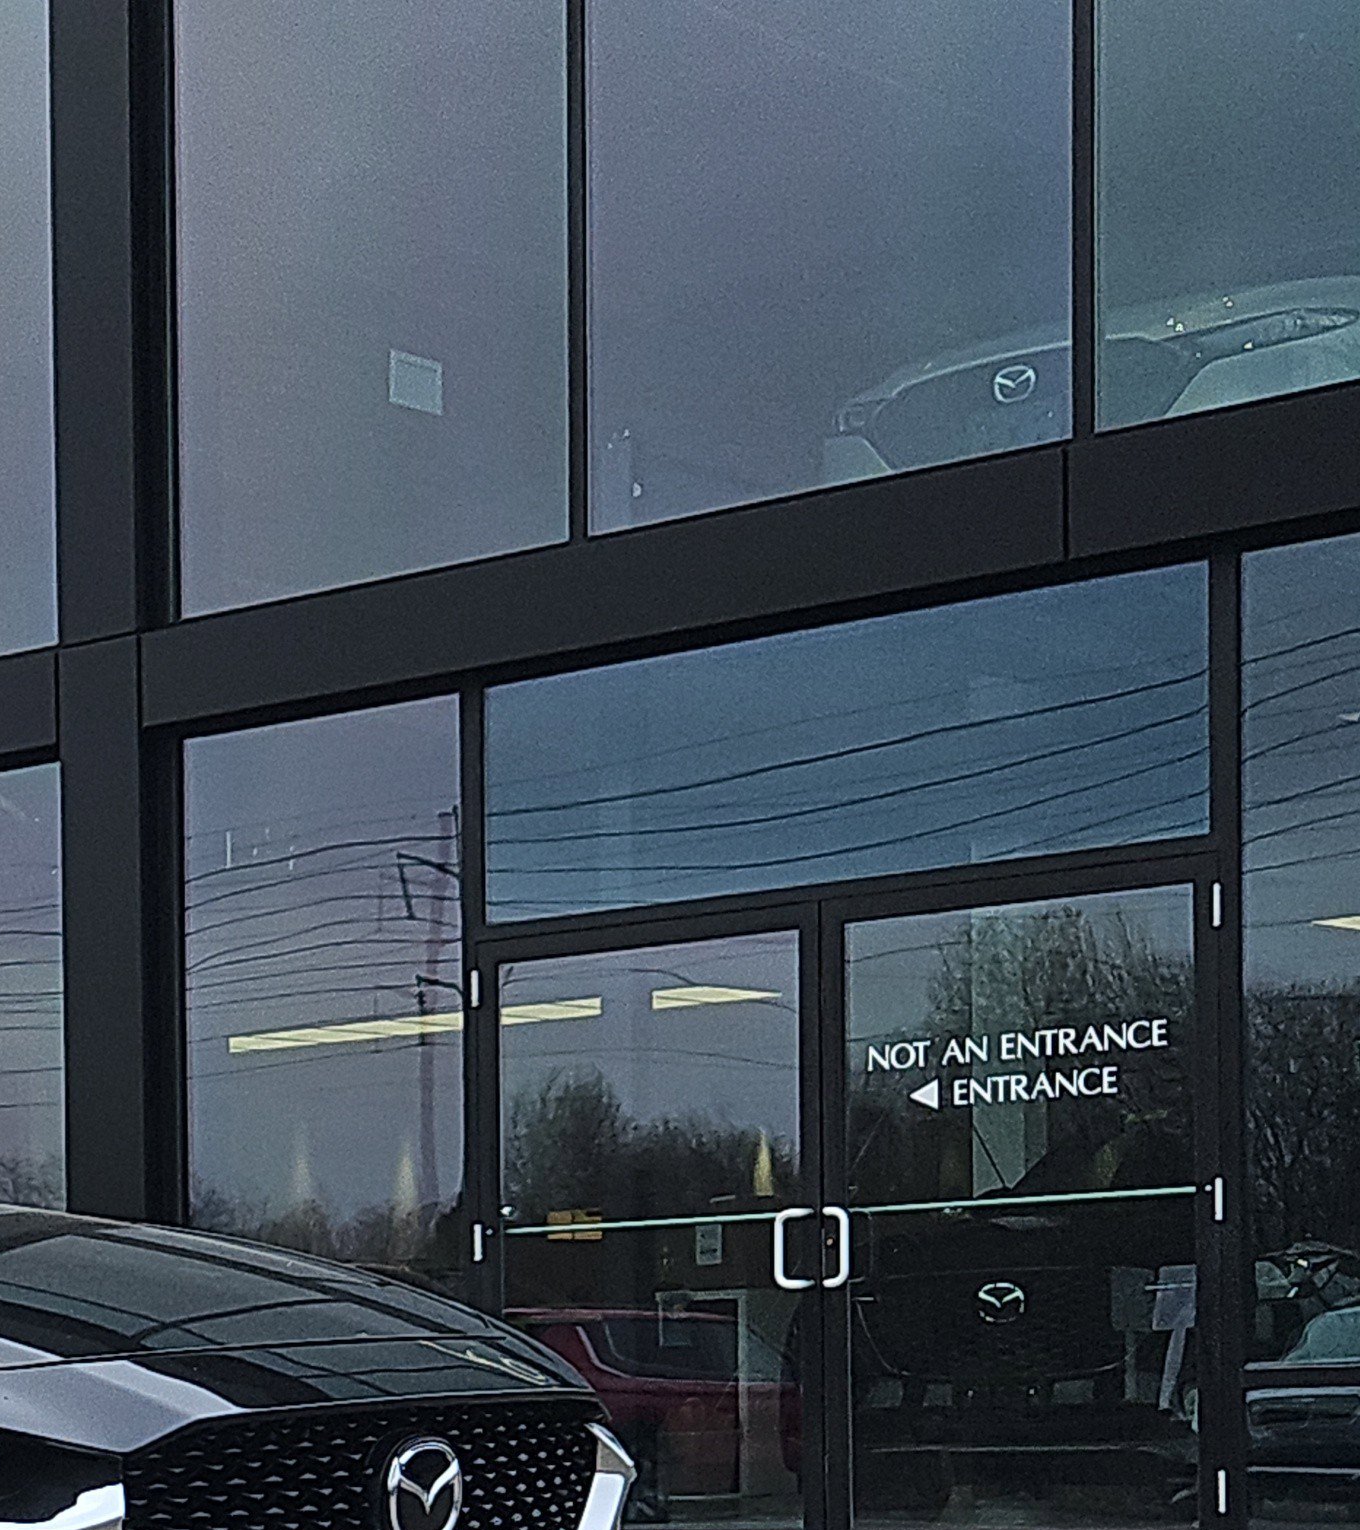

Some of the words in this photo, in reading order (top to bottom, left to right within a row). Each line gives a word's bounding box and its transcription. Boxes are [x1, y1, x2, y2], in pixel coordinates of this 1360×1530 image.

[866, 1040, 931, 1072] NOT
[941, 1035, 988, 1066] AN
[1000, 1018, 1169, 1061] ENTRANCE
[952, 1066, 1119, 1107] ENTRANCE
